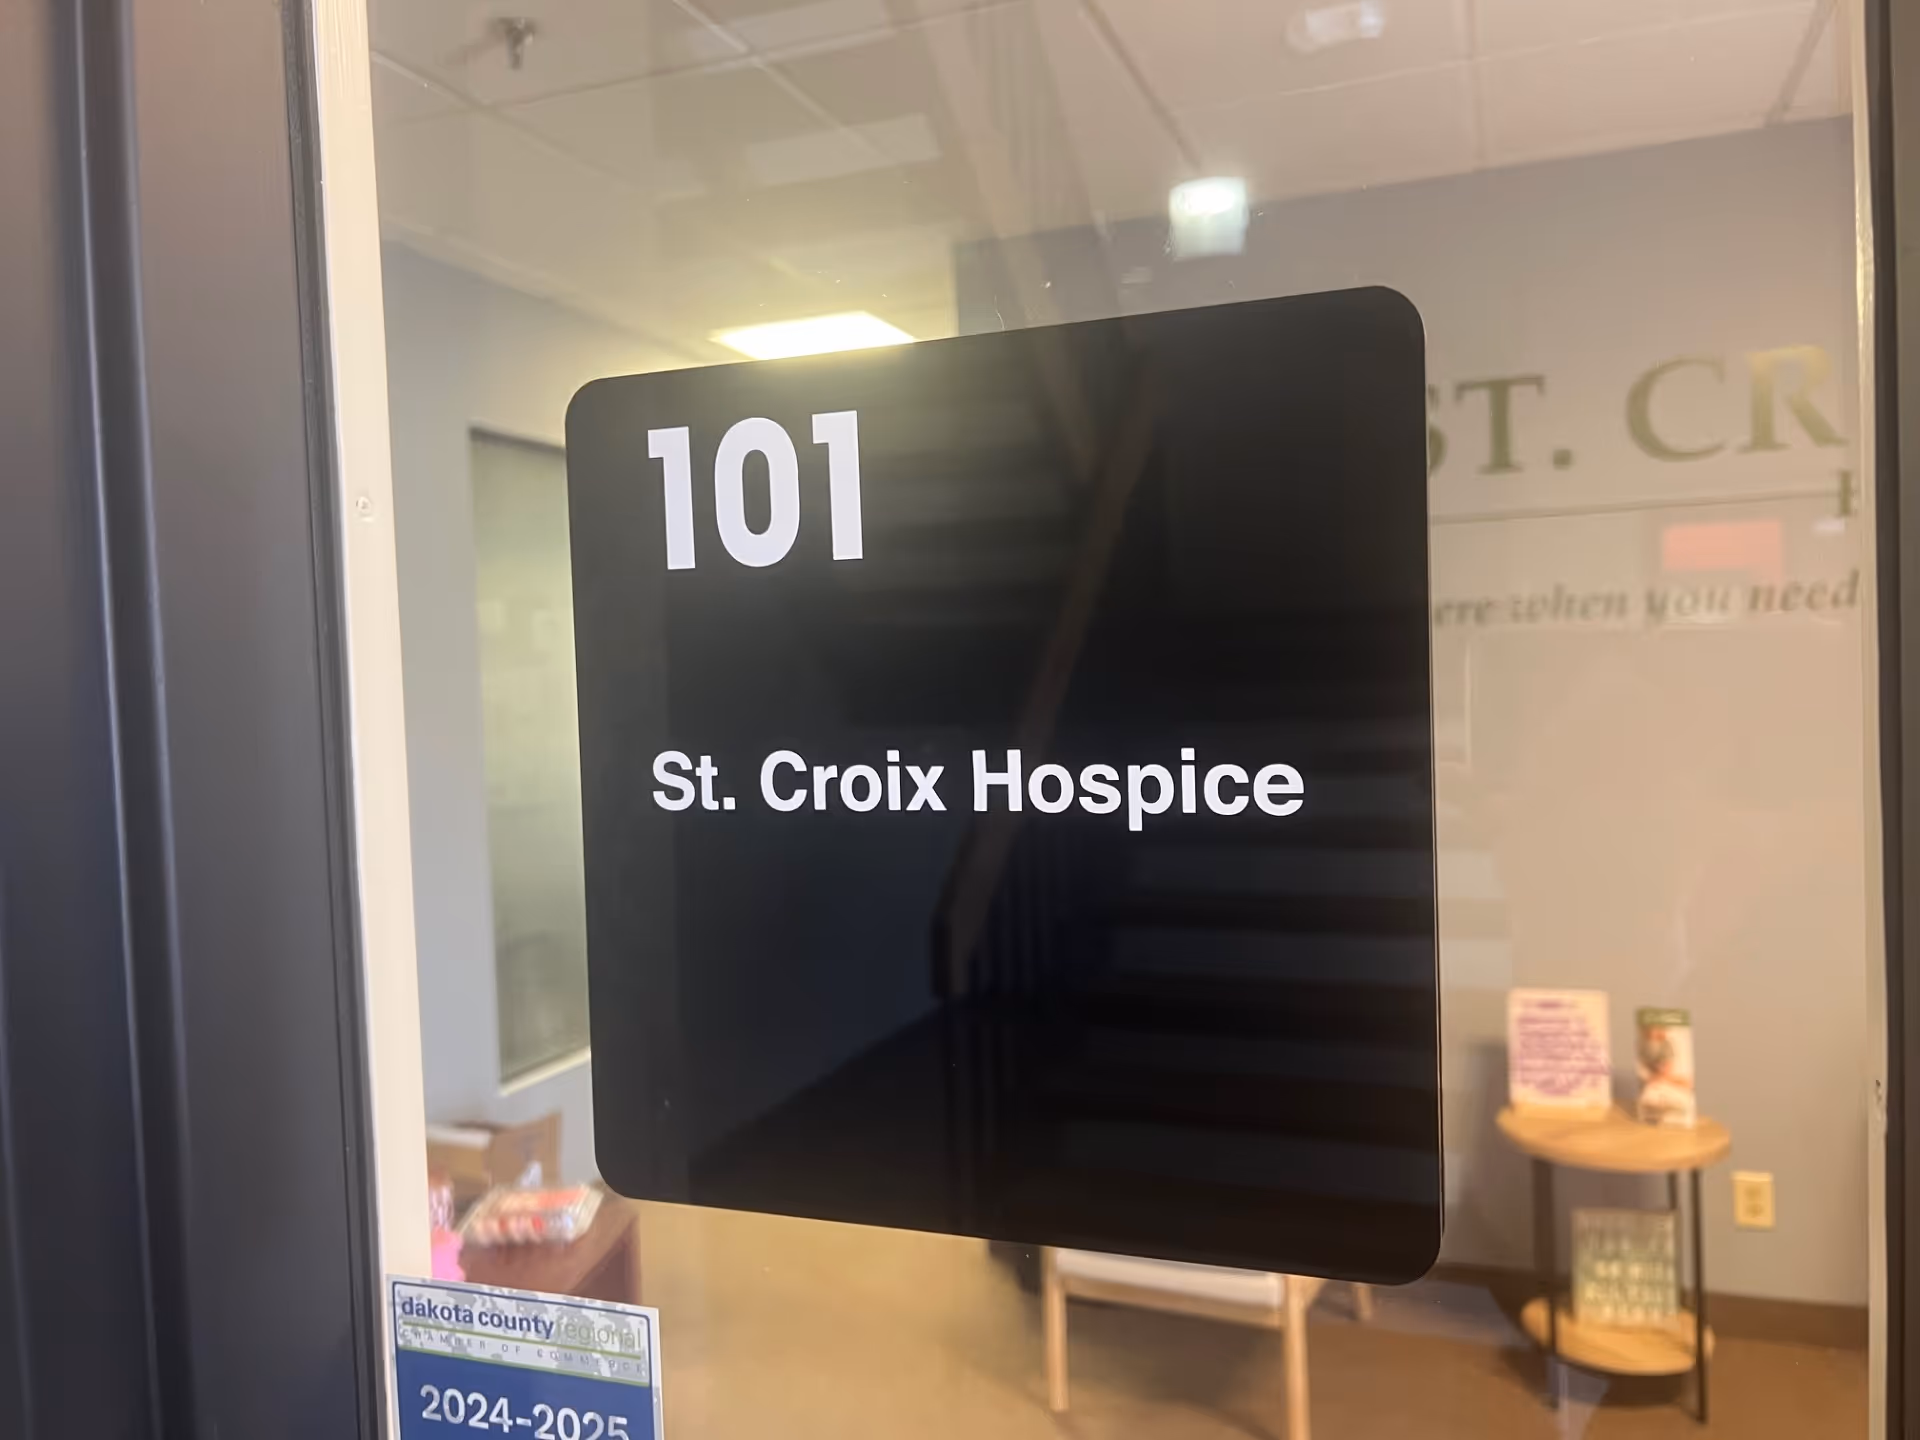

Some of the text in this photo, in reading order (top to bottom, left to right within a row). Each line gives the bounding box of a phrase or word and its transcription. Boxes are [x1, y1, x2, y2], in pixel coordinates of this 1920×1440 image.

[647, 410, 864, 570] 101
[1509, 582, 1629, 625] when
[1642, 584, 1732, 628] you
[1747, 569, 1860, 613] need
[652, 747, 1305, 831] St. Croix Hospice
[401, 1297, 474, 1325] dakota
[420, 1384, 630, 1440] 2024-2025
